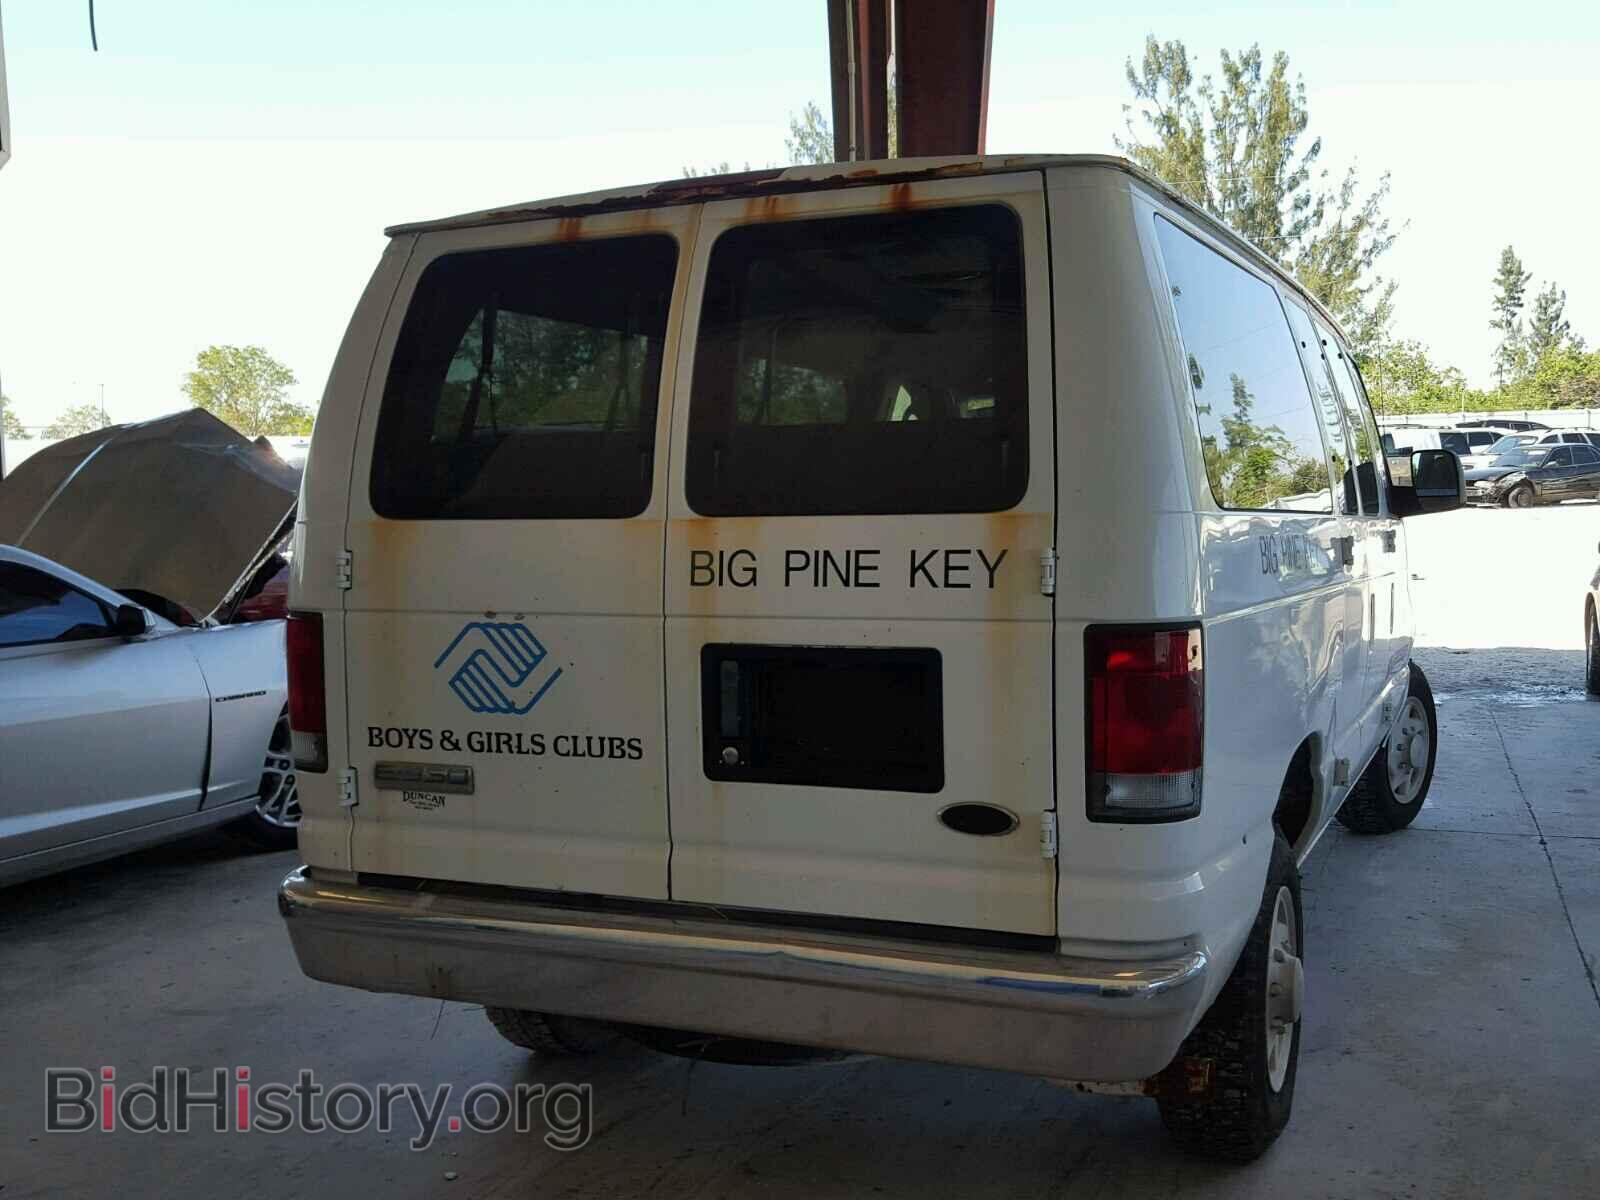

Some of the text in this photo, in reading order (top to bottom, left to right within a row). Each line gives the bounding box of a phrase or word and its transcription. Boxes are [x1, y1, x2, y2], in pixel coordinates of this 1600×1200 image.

[690, 549, 1009, 589] BIG PINE KEY
[367, 726, 643, 760] BOYS & GIRLS CLUBS
[402, 790, 446, 808] DUNCAN
